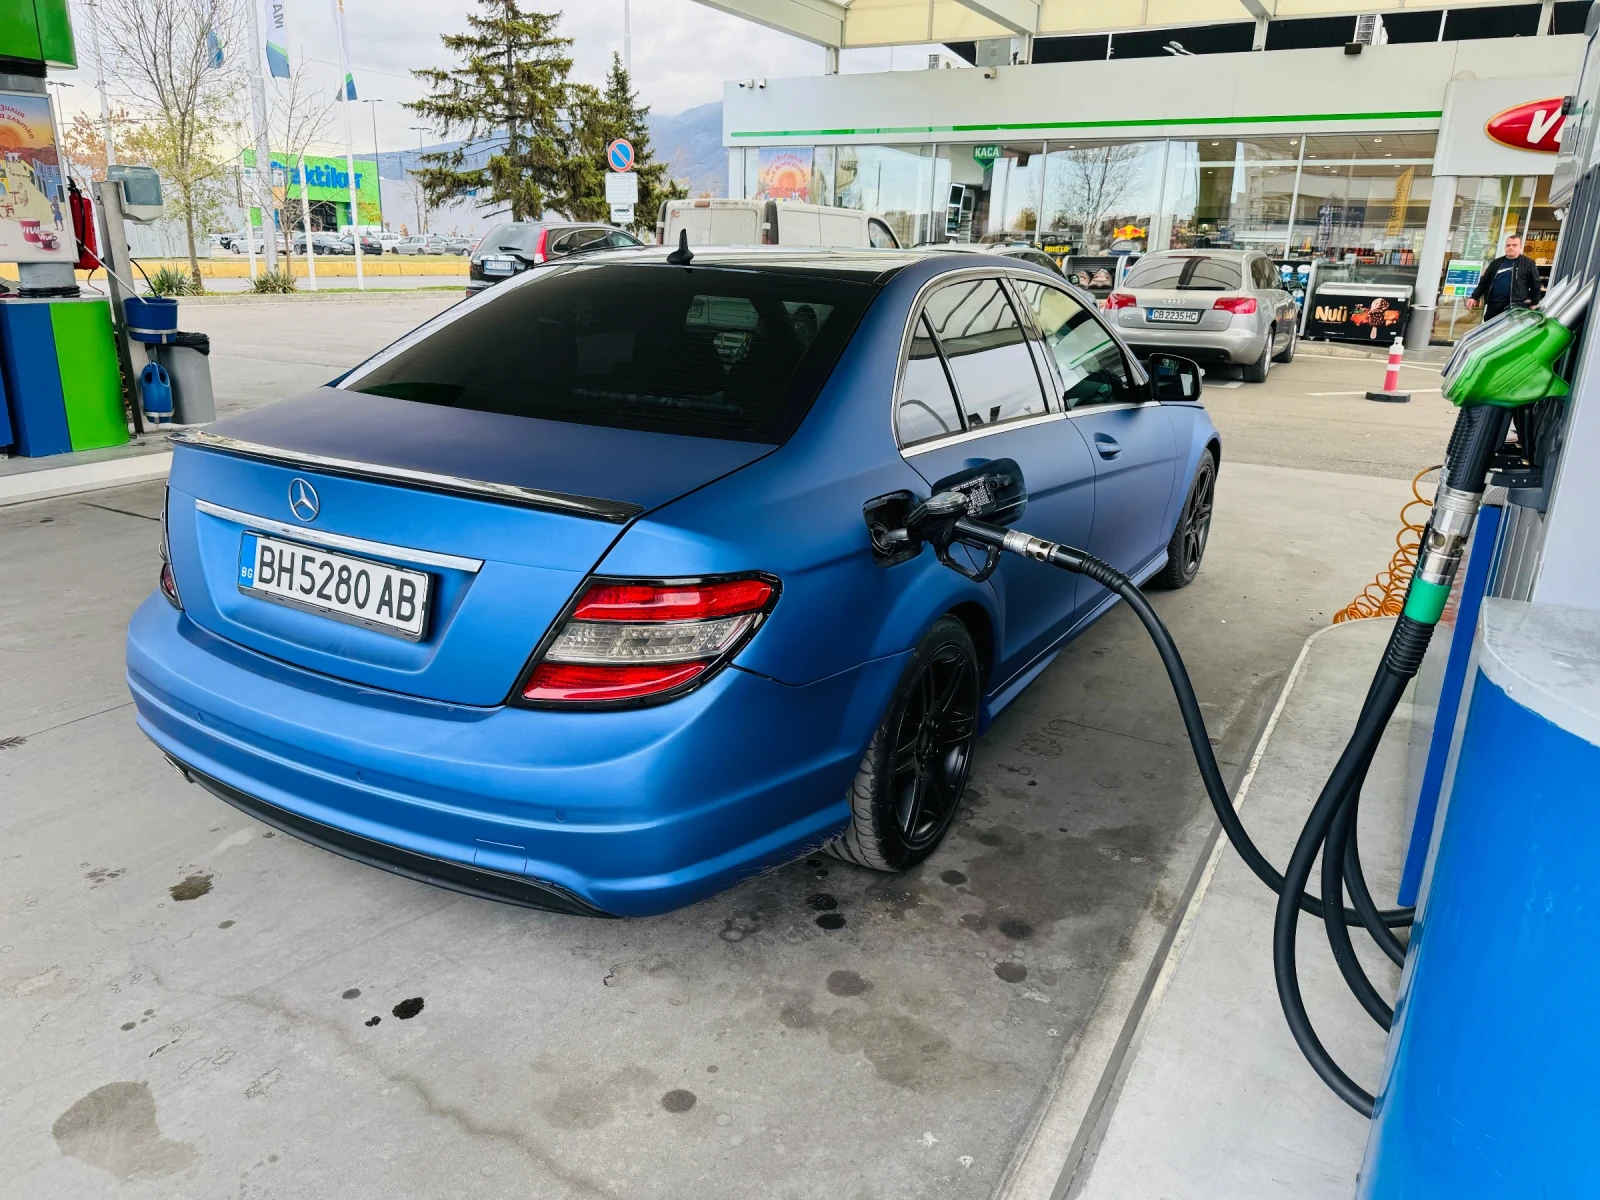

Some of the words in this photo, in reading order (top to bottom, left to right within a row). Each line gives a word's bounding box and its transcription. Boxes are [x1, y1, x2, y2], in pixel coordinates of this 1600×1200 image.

[975, 147, 1000, 157] КАСА
[1153, 311, 1164, 319] CB
[1165, 311, 1184, 320] 2235
[1185, 312, 1197, 320] HC
[241, 566, 254, 579] BG
[258, 544, 296, 591] BH
[299, 554, 371, 610] 5280
[375, 573, 417, 623] AB
